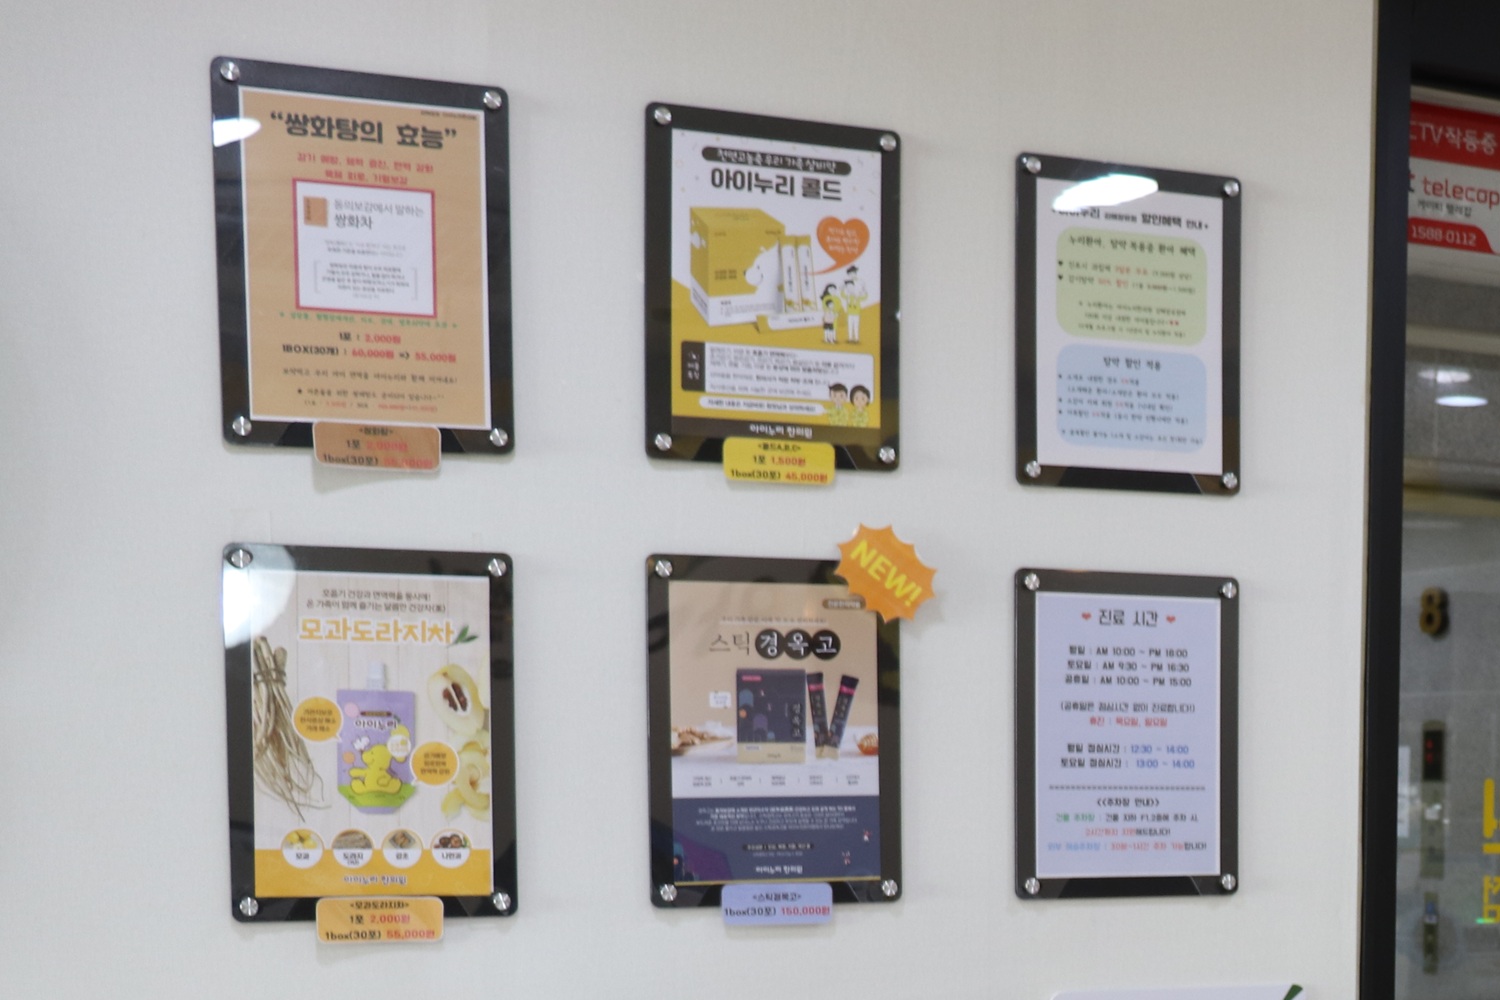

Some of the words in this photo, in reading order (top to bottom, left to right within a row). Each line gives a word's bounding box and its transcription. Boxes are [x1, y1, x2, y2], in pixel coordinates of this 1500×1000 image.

[270, 111, 383, 144] “쌍화탕의
[396, 124, 457, 149] 효능”
[711, 167, 795, 197] 아이누리
[802, 176, 842, 201] 콜드
[1422, 176, 1500, 211] telecop
[334, 214, 373, 230] 쌍화차
[1141, 213, 1182, 228] 할인혜택
[749, 424, 784, 436] 아이누리
[786, 426, 813, 439] 한의원
[753, 455, 766, 465] 1포
[770, 456, 806, 466] 1,500원
[730, 469, 781, 481] 1box(30포)
[850, 539, 922, 607] NEW!
[1099, 609, 1125, 626] 진료
[1132, 610, 1158, 628] 시간
[1419, 587, 1446, 635] 8
[300, 616, 454, 644] 모과도라지차
[708, 631, 751, 656] 스틱
[759, 631, 838, 656] 경옥고
[1096, 646, 1108, 656] AM
[1112, 646, 1136, 656] 10:00
[1149, 648, 1161, 657] PM
[1067, 660, 1092, 670] 토요일
[1102, 661, 1115, 671] AM
[1118, 661, 1138, 671] 9:30
[1151, 662, 1163, 672] PM
[1167, 663, 1190, 672] 16:30
[1100, 676, 1112, 685] AM
[1116, 676, 1140, 686] 10:00
[1152, 677, 1165, 686] PM
[1169, 677, 1192, 687] 15:00
[1088, 744, 1120, 754] 점심시간
[1130, 745, 1152, 754] 12:30
[1166, 745, 1189, 754] 14:00
[1061, 758, 1085, 768] 토요일
[1090, 758, 1122, 768] 점심시간
[1136, 759, 1158, 768] 13:00
[1172, 759, 1195, 768] 14:00
[350, 915, 365, 924] 1포
[370, 914, 410, 924] 2,000원
[724, 907, 777, 917] 1box(30포)
[325, 931, 382, 941] 1box(30포)
